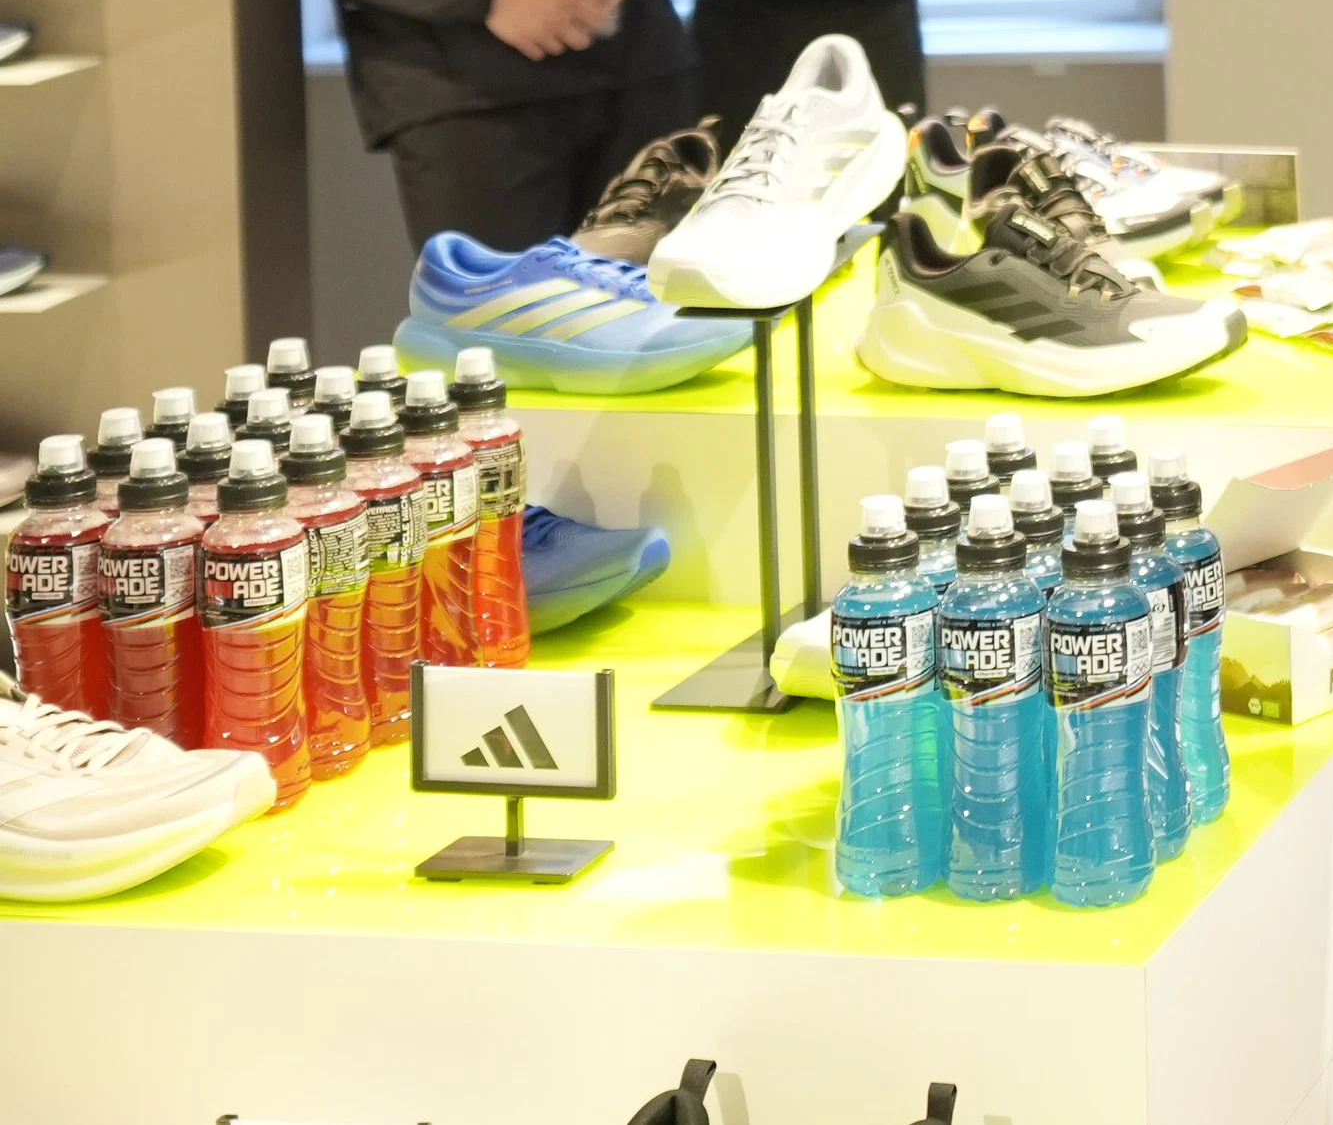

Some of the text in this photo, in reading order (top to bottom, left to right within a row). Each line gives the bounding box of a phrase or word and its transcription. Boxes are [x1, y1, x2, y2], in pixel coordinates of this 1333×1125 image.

[424, 496, 453, 514] DE
[98, 557, 159, 577] POWER
[204, 559, 280, 580] POWER
[1186, 561, 1222, 588] WER
[22, 574, 68, 592] ADE
[115, 576, 160, 596] ADE
[232, 578, 281, 599] ADE
[1193, 579, 1223, 607] ADE
[832, 626, 901, 648] POWER
[942, 629, 1010, 650] POWER
[1051, 633, 1123, 655] POWER
[857, 647, 902, 668] ADE
[965, 649, 1011, 670] ADE
[1077, 652, 1124, 675] ADE
